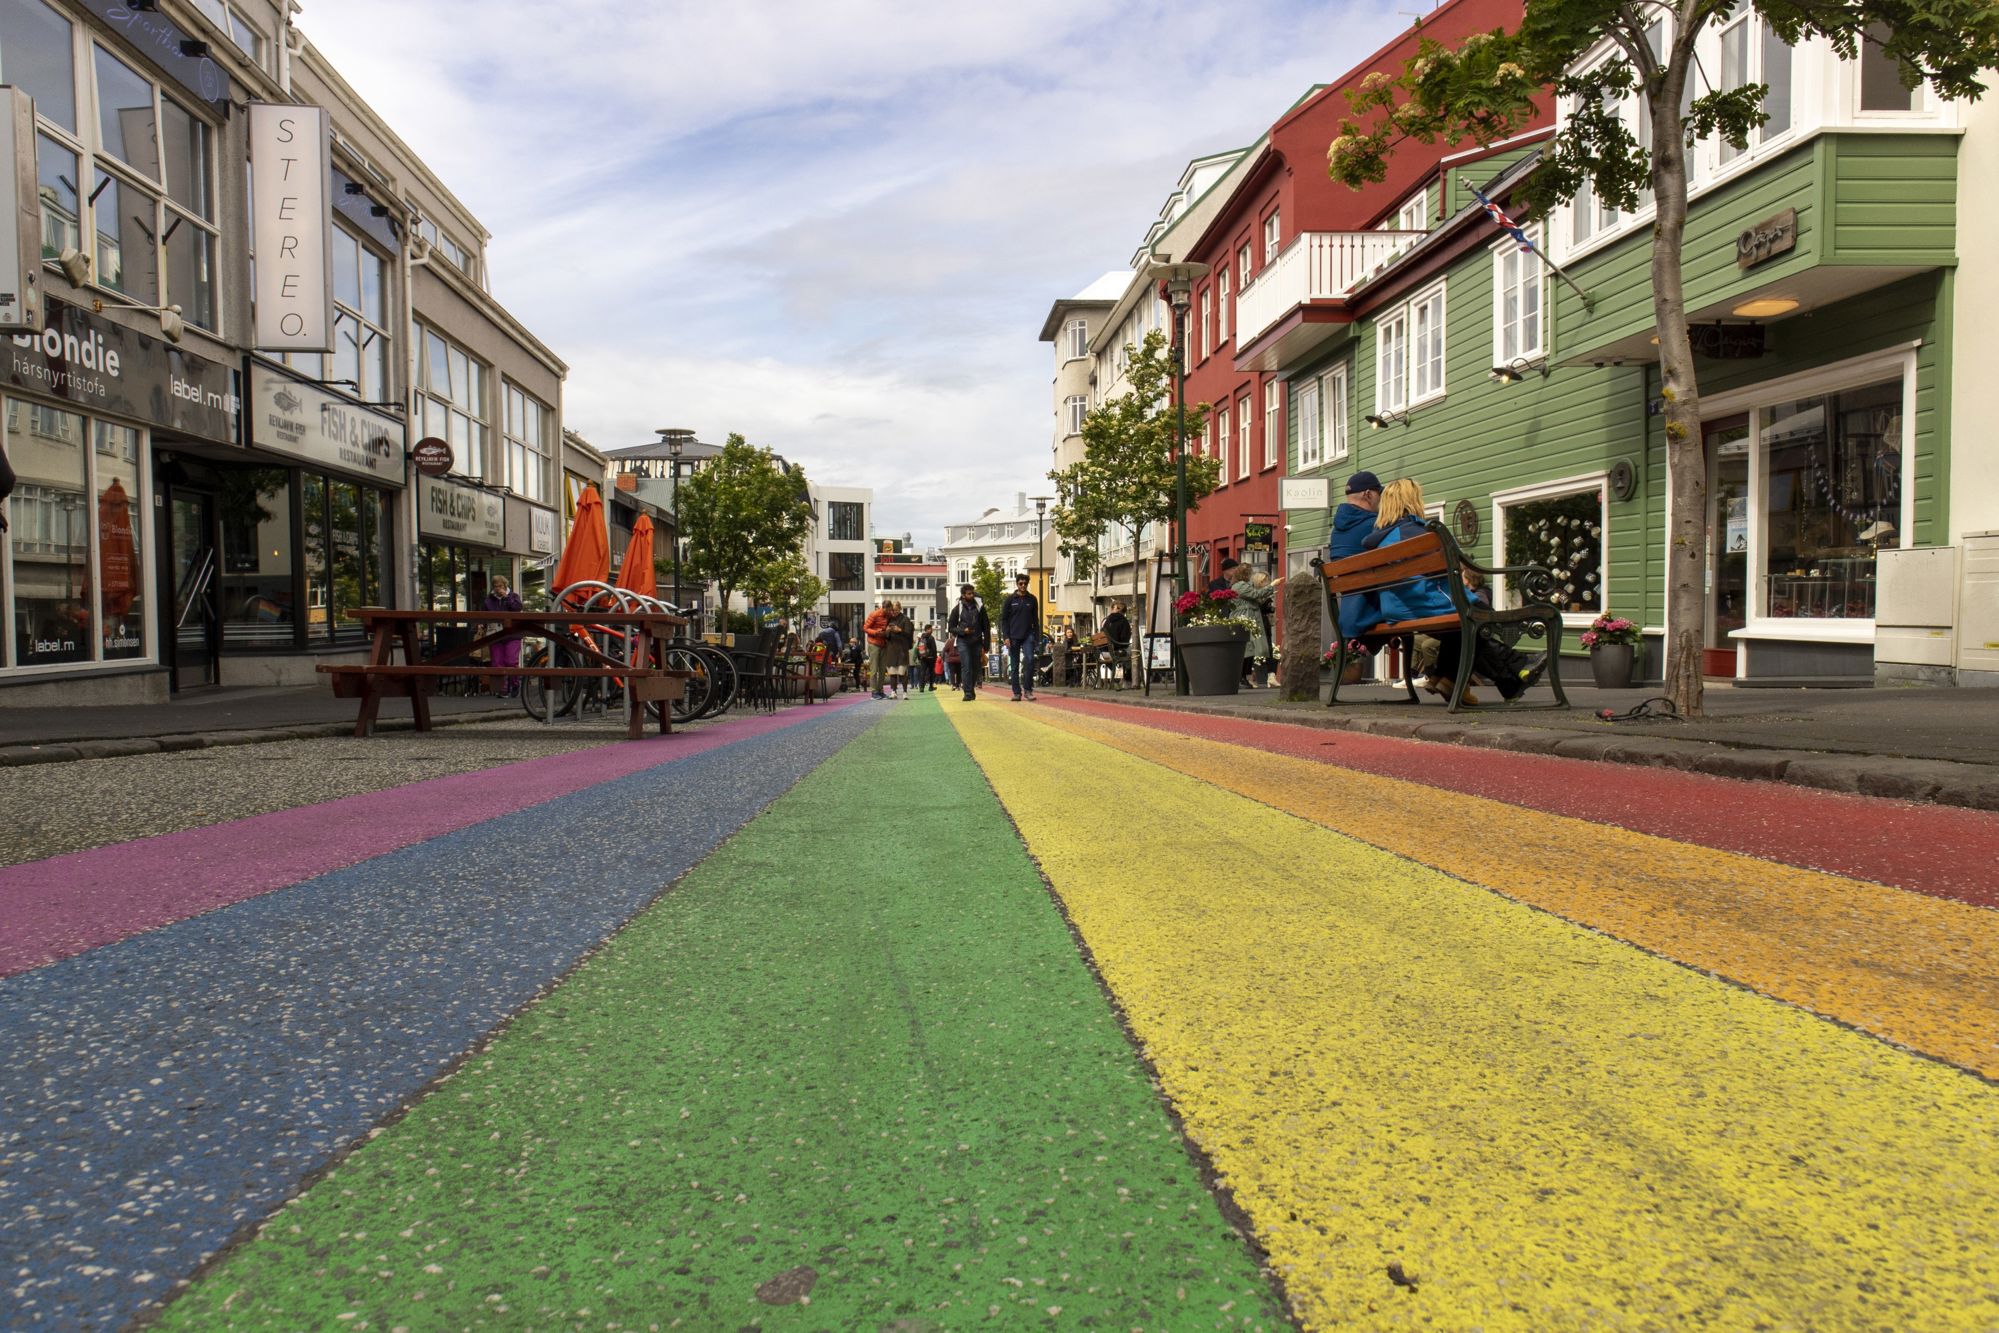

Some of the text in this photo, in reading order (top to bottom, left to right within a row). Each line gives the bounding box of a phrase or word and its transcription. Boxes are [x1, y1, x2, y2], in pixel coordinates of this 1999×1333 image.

[13, 352, 106, 397] hársnyrtistofa
[269, 414, 306, 436] REYKJAVIK FISH
[321, 403, 390, 458] FISH & CHIPS
[276, 430, 299, 443] RESTAURANT
[339, 448, 377, 470] RESTAURANT
[1286, 487, 1323, 497] Kaolin
[431, 486, 476, 522] FISH & CHIPS
[442, 518, 467, 532] RESTAURANT
[1174, 544, 1209, 556] KKA
[35, 638, 75, 652] label.m
